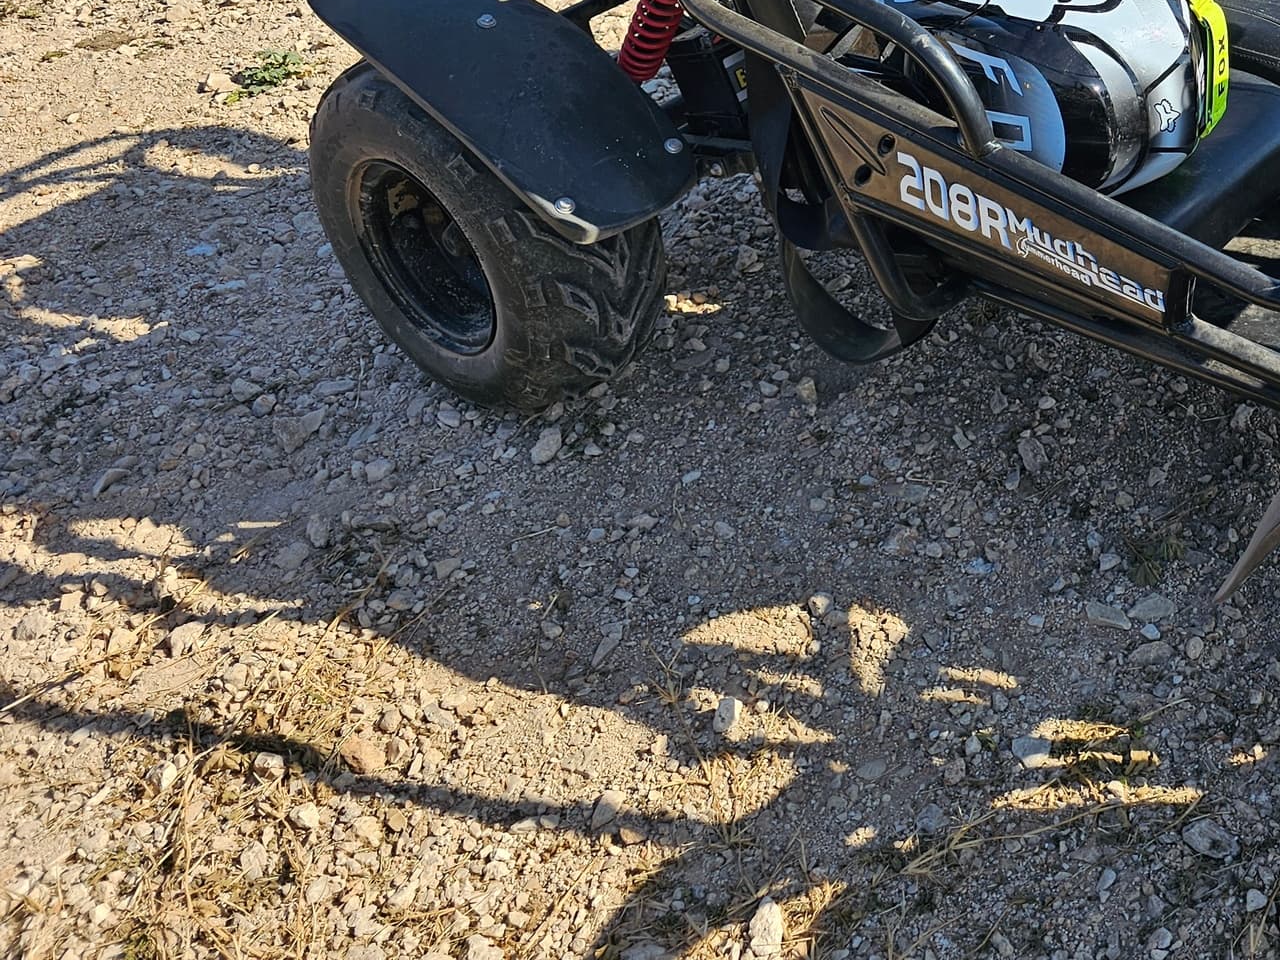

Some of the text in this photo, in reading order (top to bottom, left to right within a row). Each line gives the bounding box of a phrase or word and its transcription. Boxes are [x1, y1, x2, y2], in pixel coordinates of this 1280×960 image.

[947, 41, 1032, 152] FO
[1218, 35, 1226, 97] FOX
[897, 152, 1166, 312] 208R Mudhead
